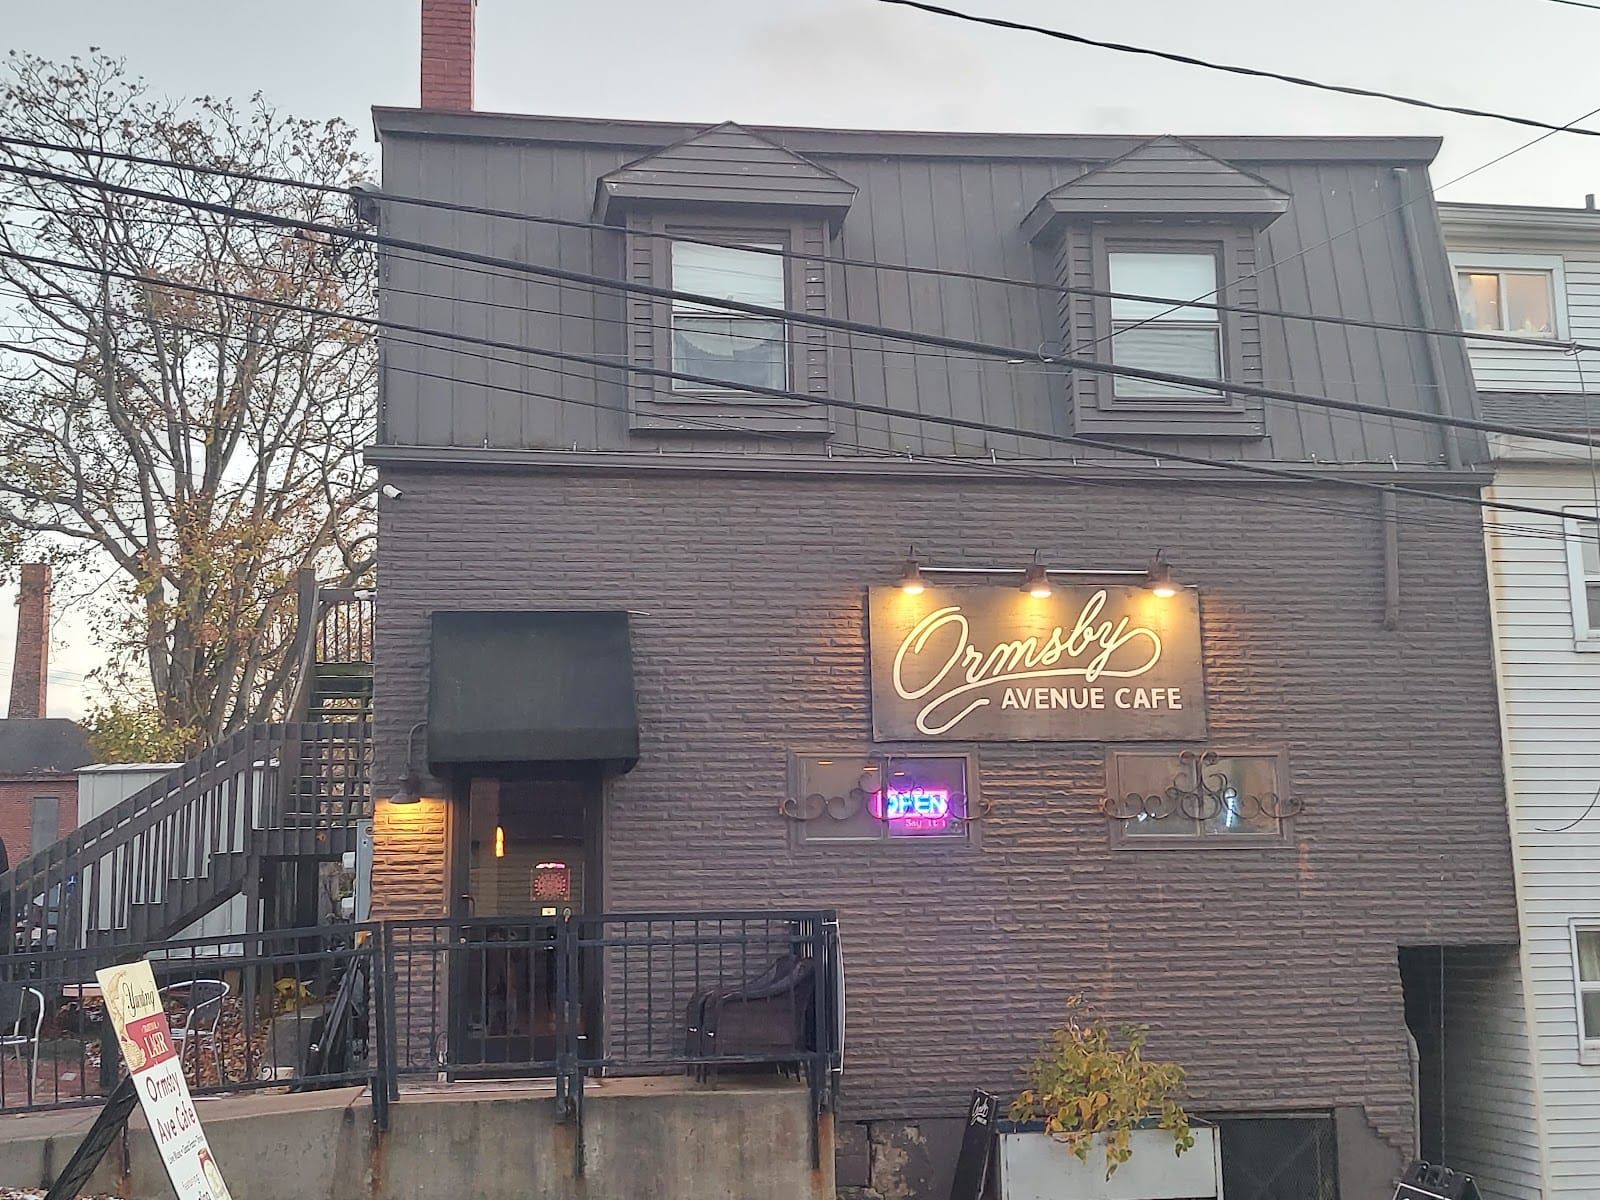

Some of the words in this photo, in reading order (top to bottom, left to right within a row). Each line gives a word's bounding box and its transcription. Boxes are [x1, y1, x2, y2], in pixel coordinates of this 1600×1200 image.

[893, 589, 1162, 735] Ormsby
[1001, 687, 1104, 710] AVENUE
[1115, 687, 1183, 710] CAFE
[886, 793, 946, 814] OPEN
[156, 1118, 177, 1144] Ave
[175, 1100, 196, 1131] Cafe
